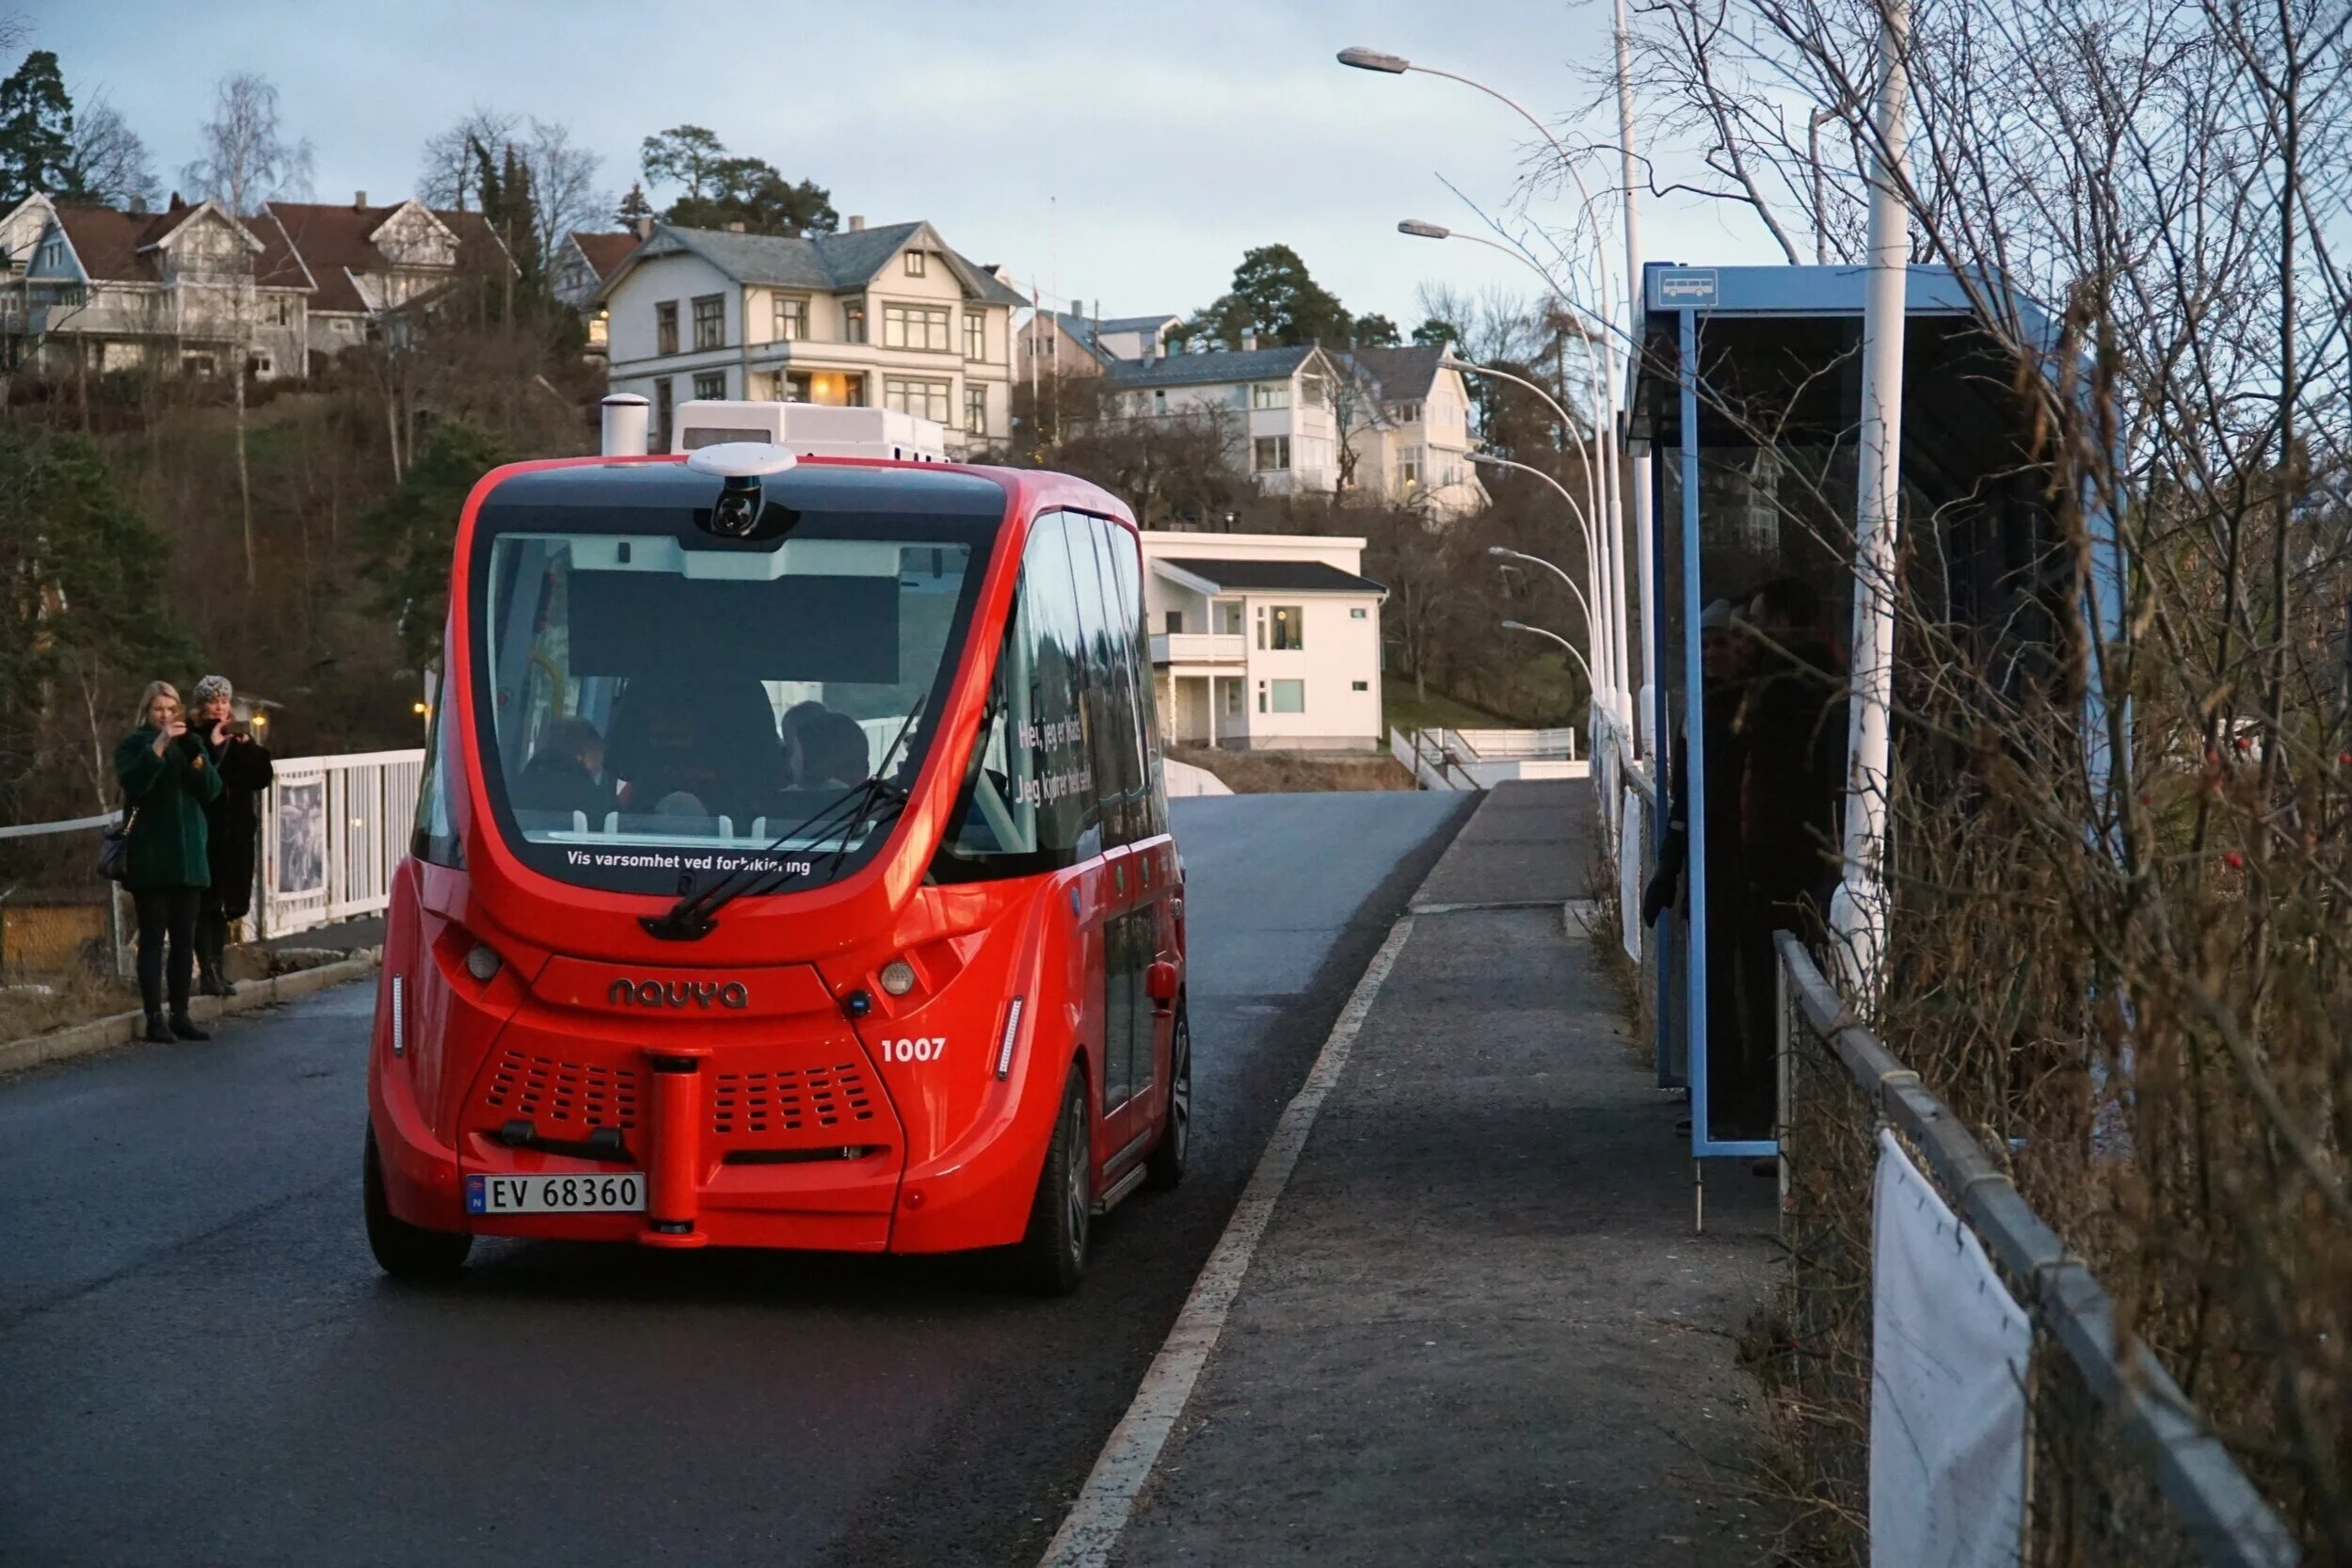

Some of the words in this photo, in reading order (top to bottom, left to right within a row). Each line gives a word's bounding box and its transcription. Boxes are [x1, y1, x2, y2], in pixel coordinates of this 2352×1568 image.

[1018, 718, 1043, 752] Hei,
[1043, 717, 1058, 753] jeg
[1016, 774, 1041, 808] Jeg
[567, 850, 591, 865] Vis
[595, 853, 680, 869] varsomhet
[683, 855, 712, 870] ved
[881, 1037, 946, 1063] 1007
[472, 1198, 482, 1208] N
[492, 1179, 528, 1208] EV
[543, 1177, 636, 1208] 68360
